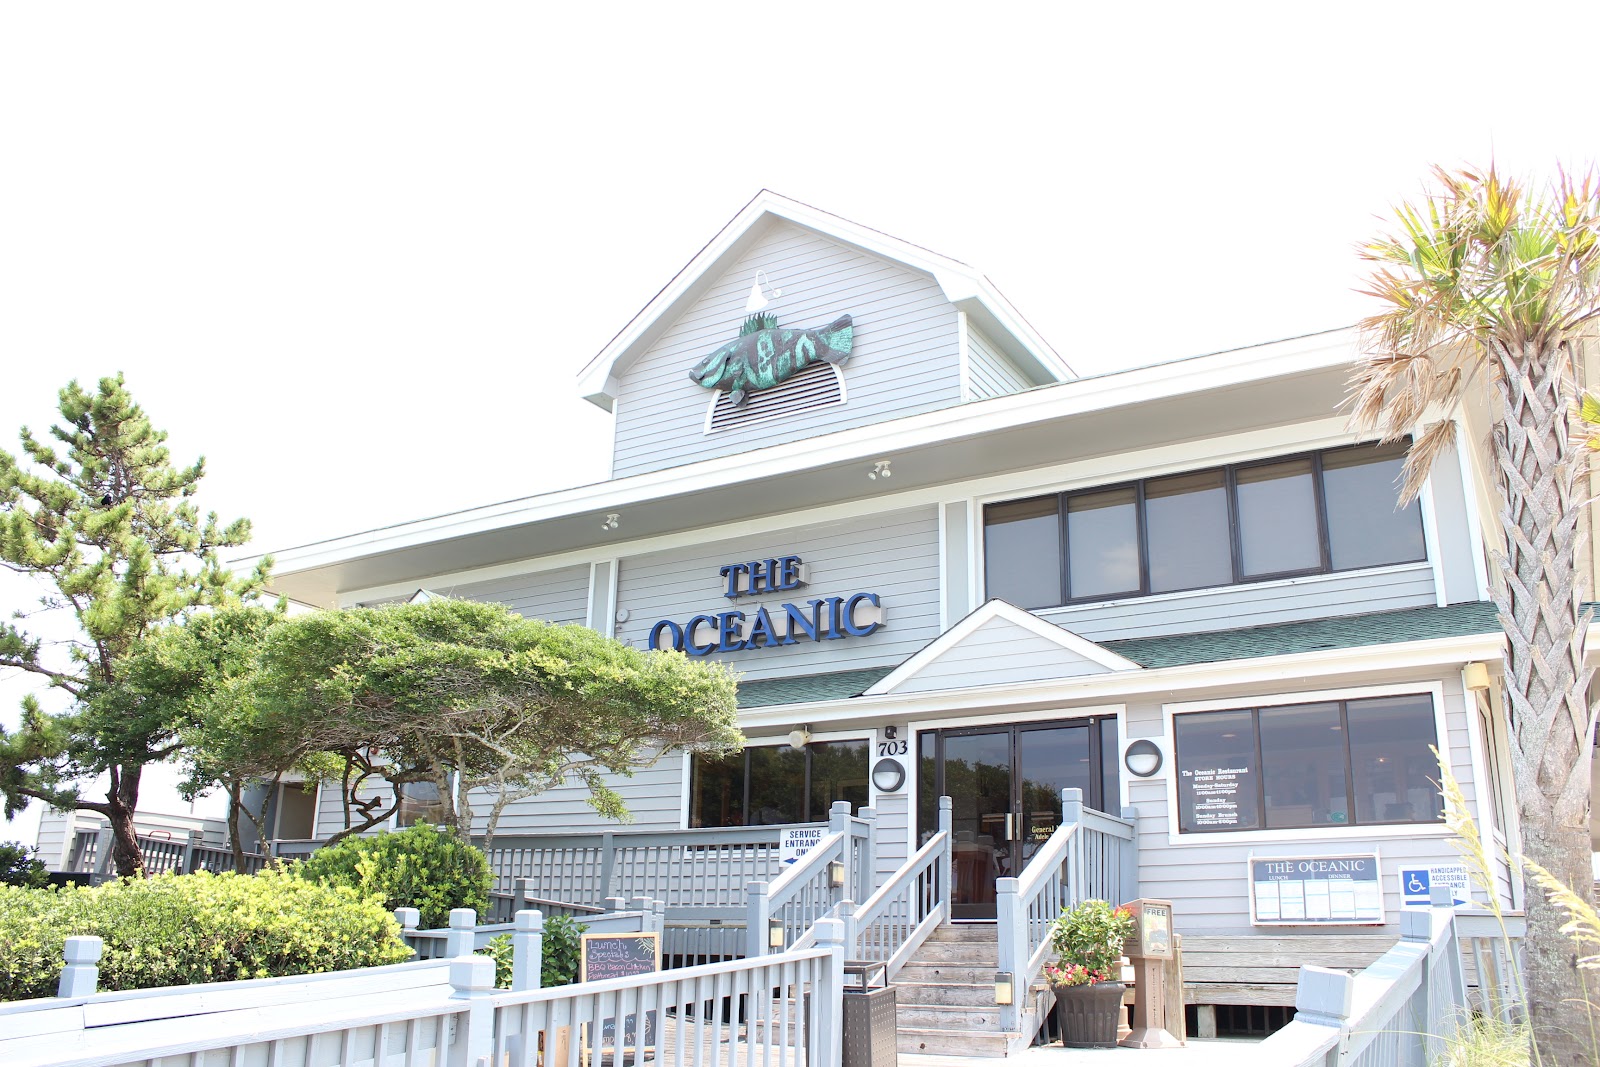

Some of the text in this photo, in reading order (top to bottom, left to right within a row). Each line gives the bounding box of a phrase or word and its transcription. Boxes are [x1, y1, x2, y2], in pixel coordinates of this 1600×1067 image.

[720, 555, 802, 598] THE
[648, 592, 880, 656] OCEANIC
[878, 740, 908, 756] 703
[1031, 825, 1055, 834] General
[789, 830, 821, 838] SERVICE
[785, 839, 822, 847] ENTRANC
[796, 848, 811, 856] ON
[1265, 860, 1365, 874] THE OCEANIC
[1430, 866, 1467, 874] HANDICAPPED
[1146, 909, 1166, 917] FREE
[588, 939, 627, 950] Lunch
[588, 963, 606, 971] BBQ
[625, 963, 651, 971] Chicken
